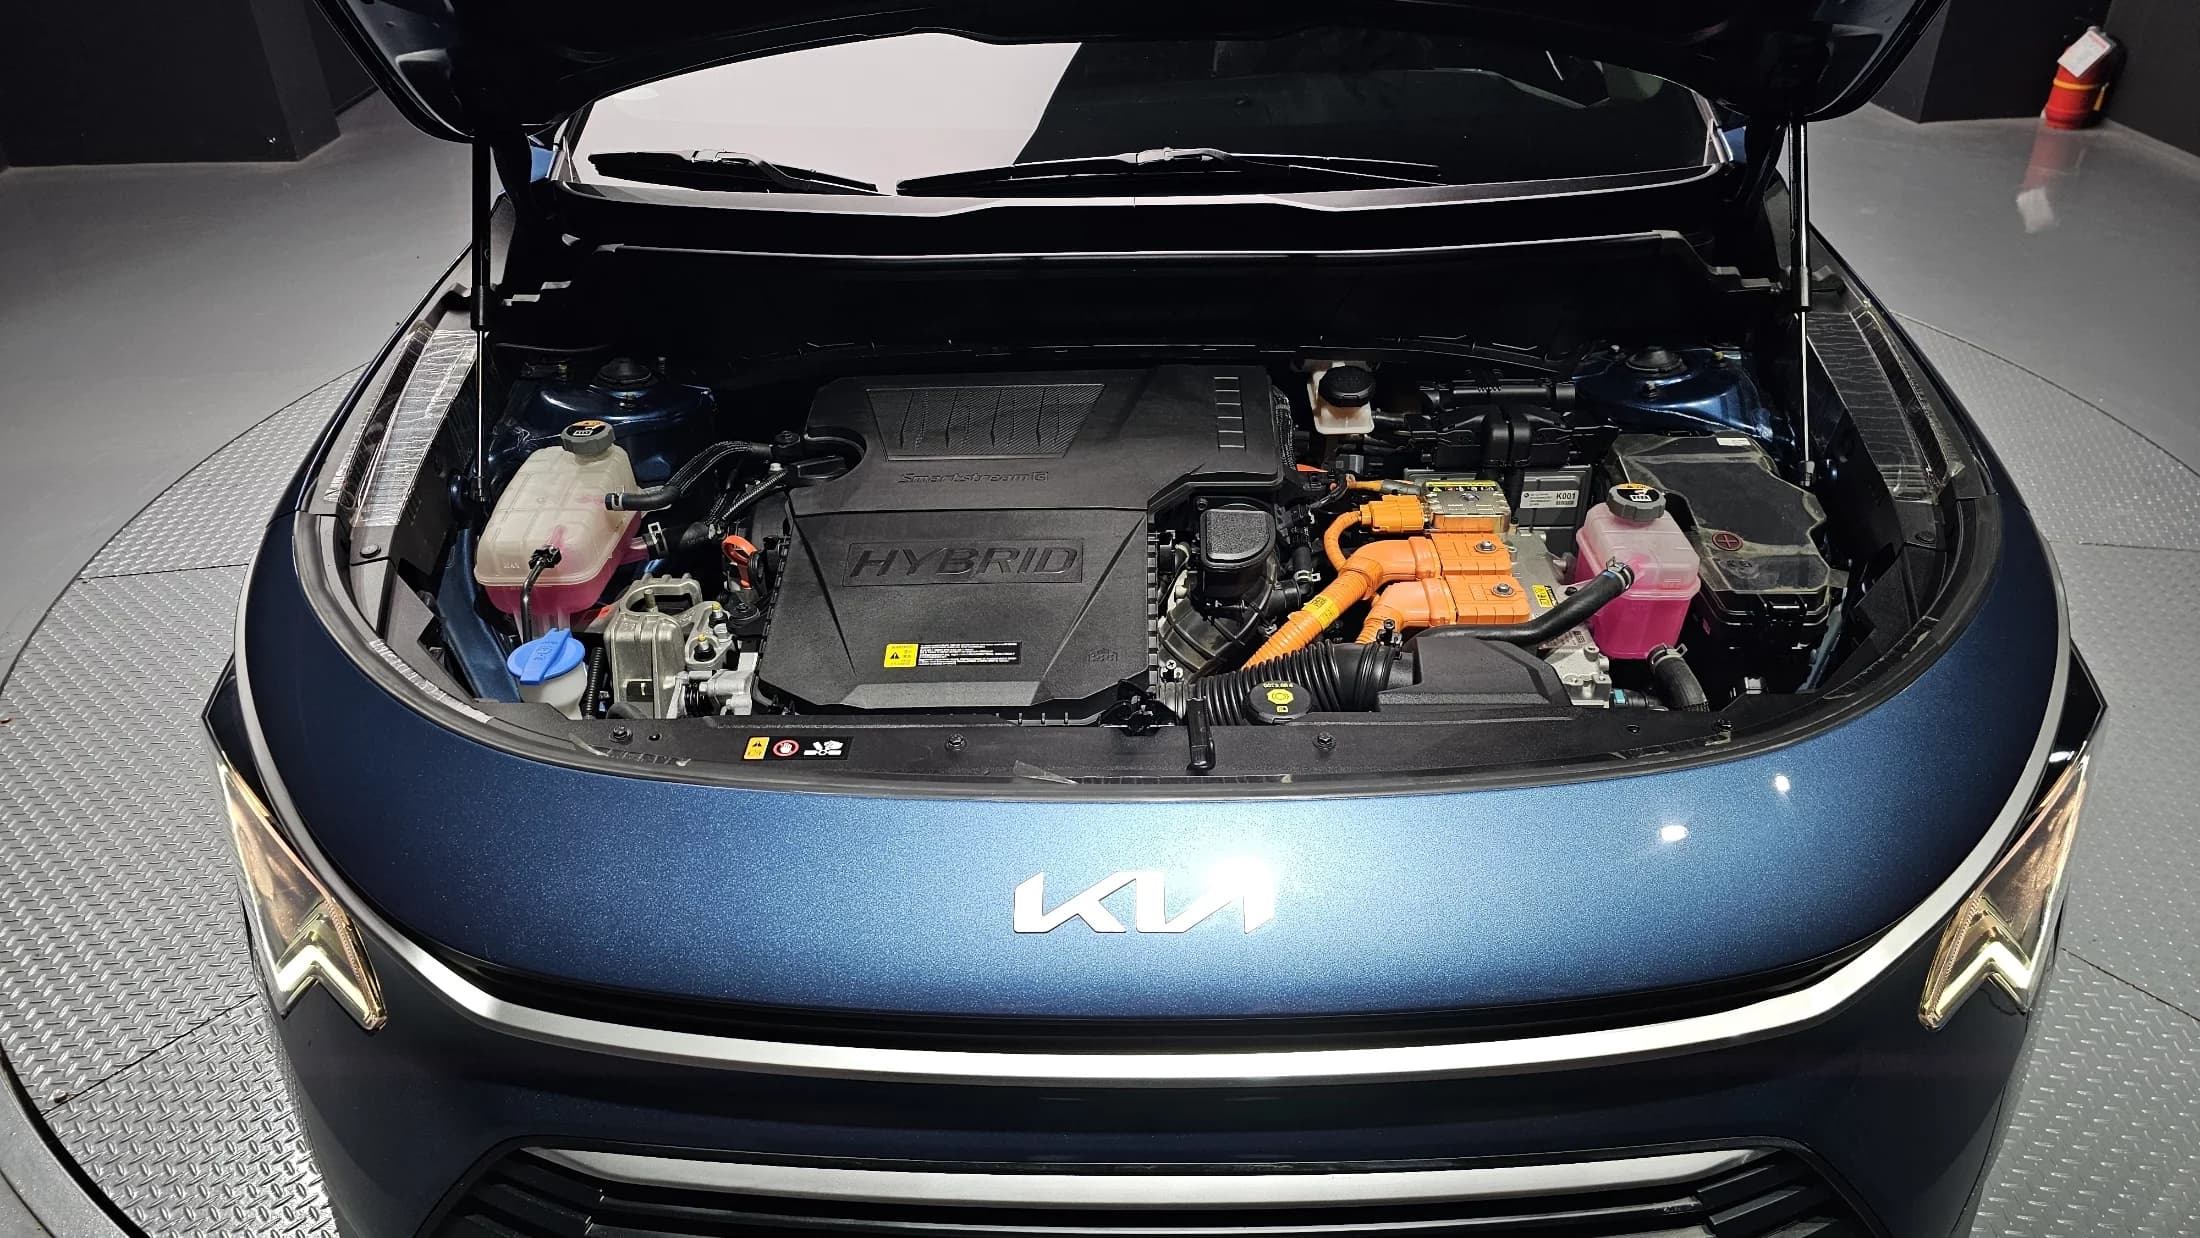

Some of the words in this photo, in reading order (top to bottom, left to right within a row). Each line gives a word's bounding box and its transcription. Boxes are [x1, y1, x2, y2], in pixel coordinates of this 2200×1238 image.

[1556, 492, 1576, 500] K001
[849, 547, 1078, 577] HYBRID
[1013, 870, 1275, 934] KIA
